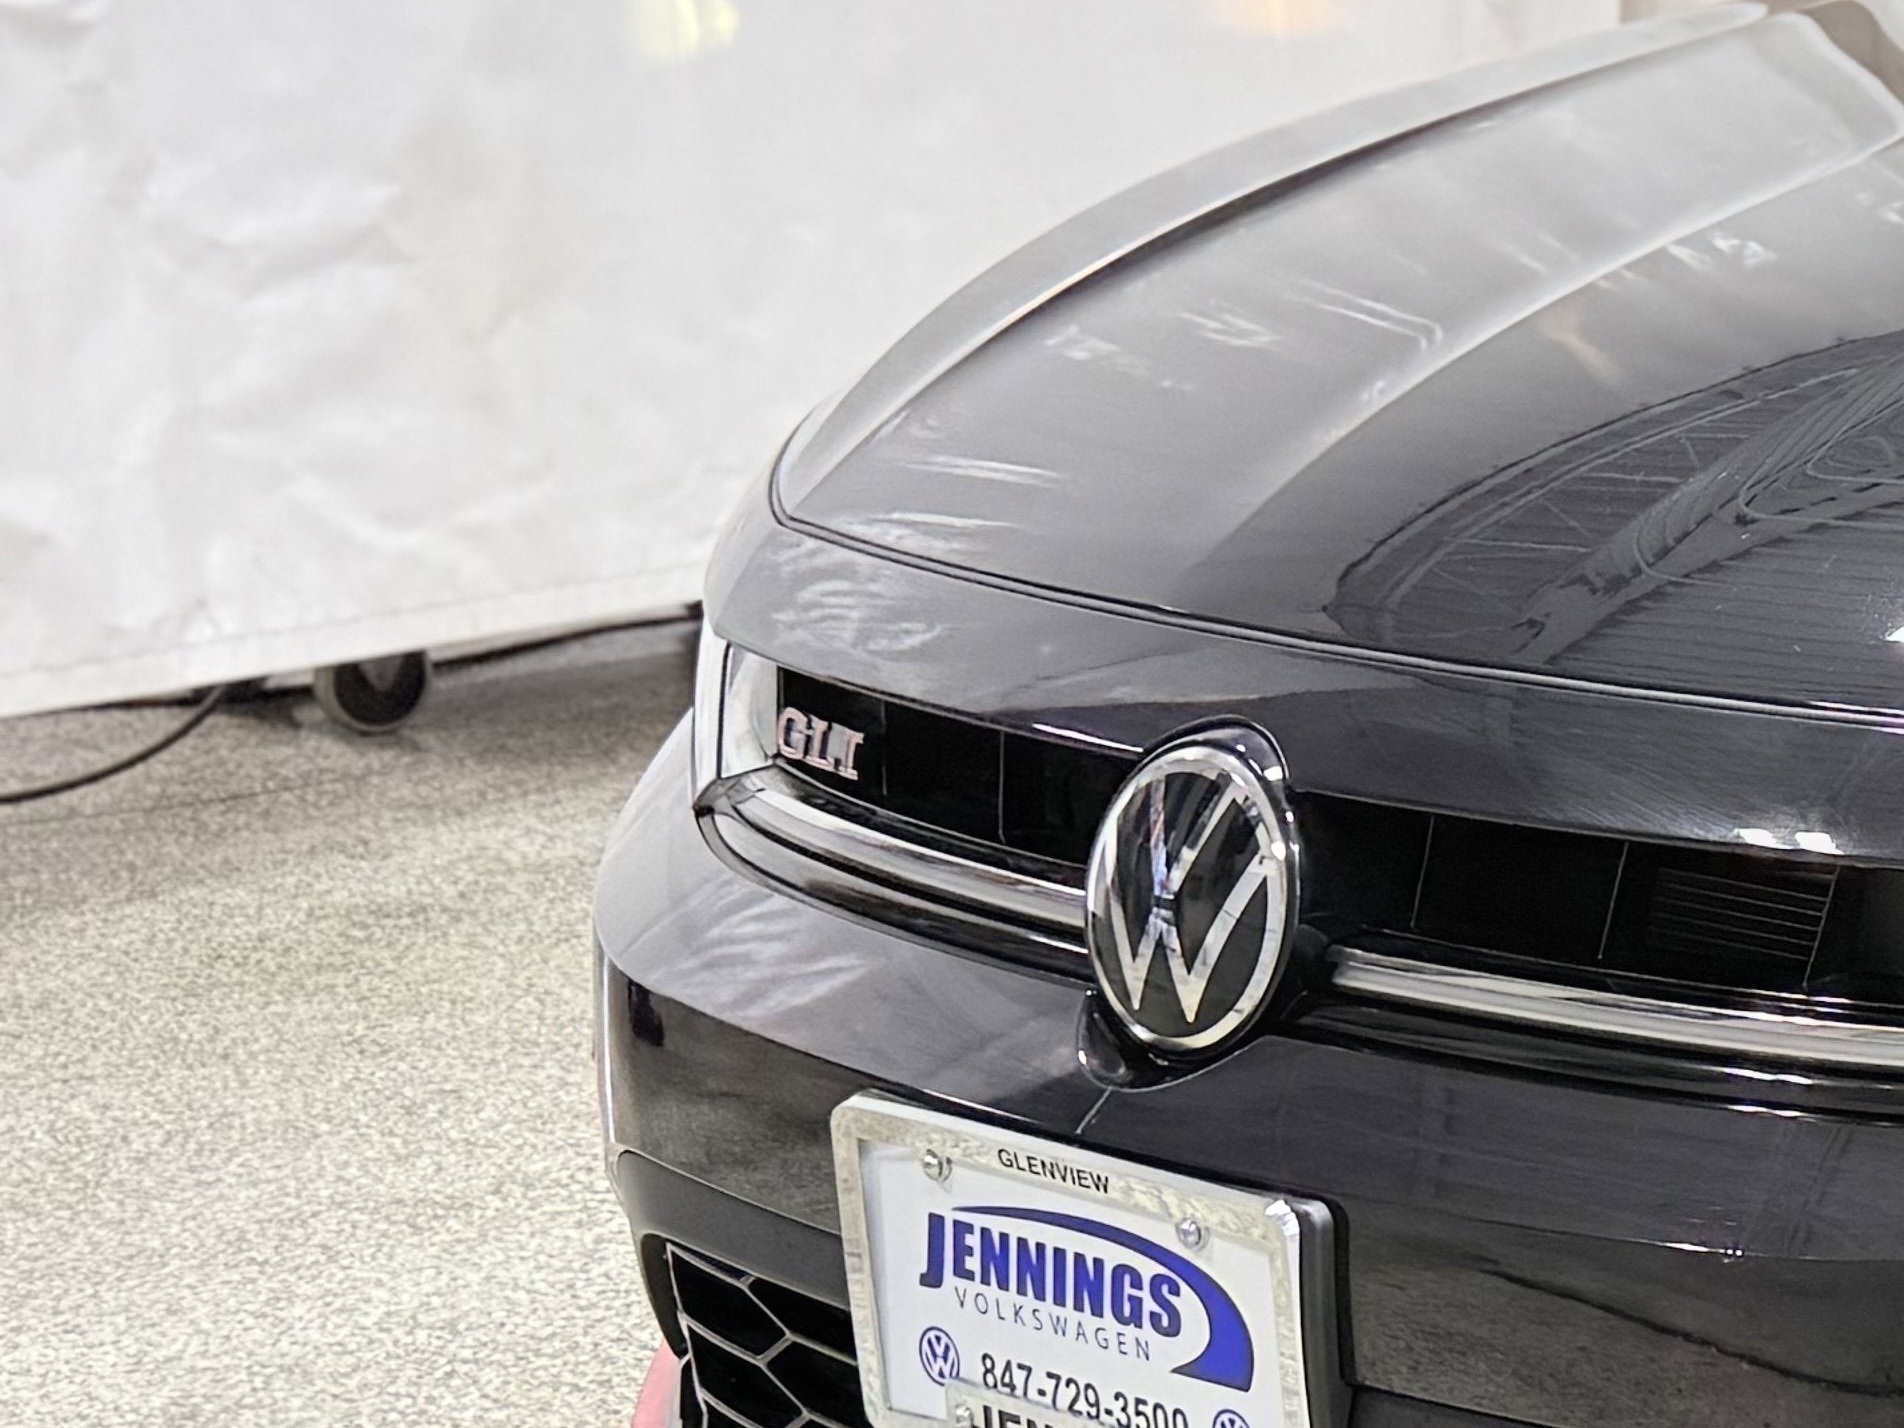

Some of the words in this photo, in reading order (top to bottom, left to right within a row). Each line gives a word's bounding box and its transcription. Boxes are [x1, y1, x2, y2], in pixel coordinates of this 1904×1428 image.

[778, 705, 865, 781] GLI
[997, 1148, 1110, 1195] GLENVIEW
[918, 1211, 1182, 1339] JENNINGS
[954, 1285, 1152, 1362] VOLKSWAGEN
